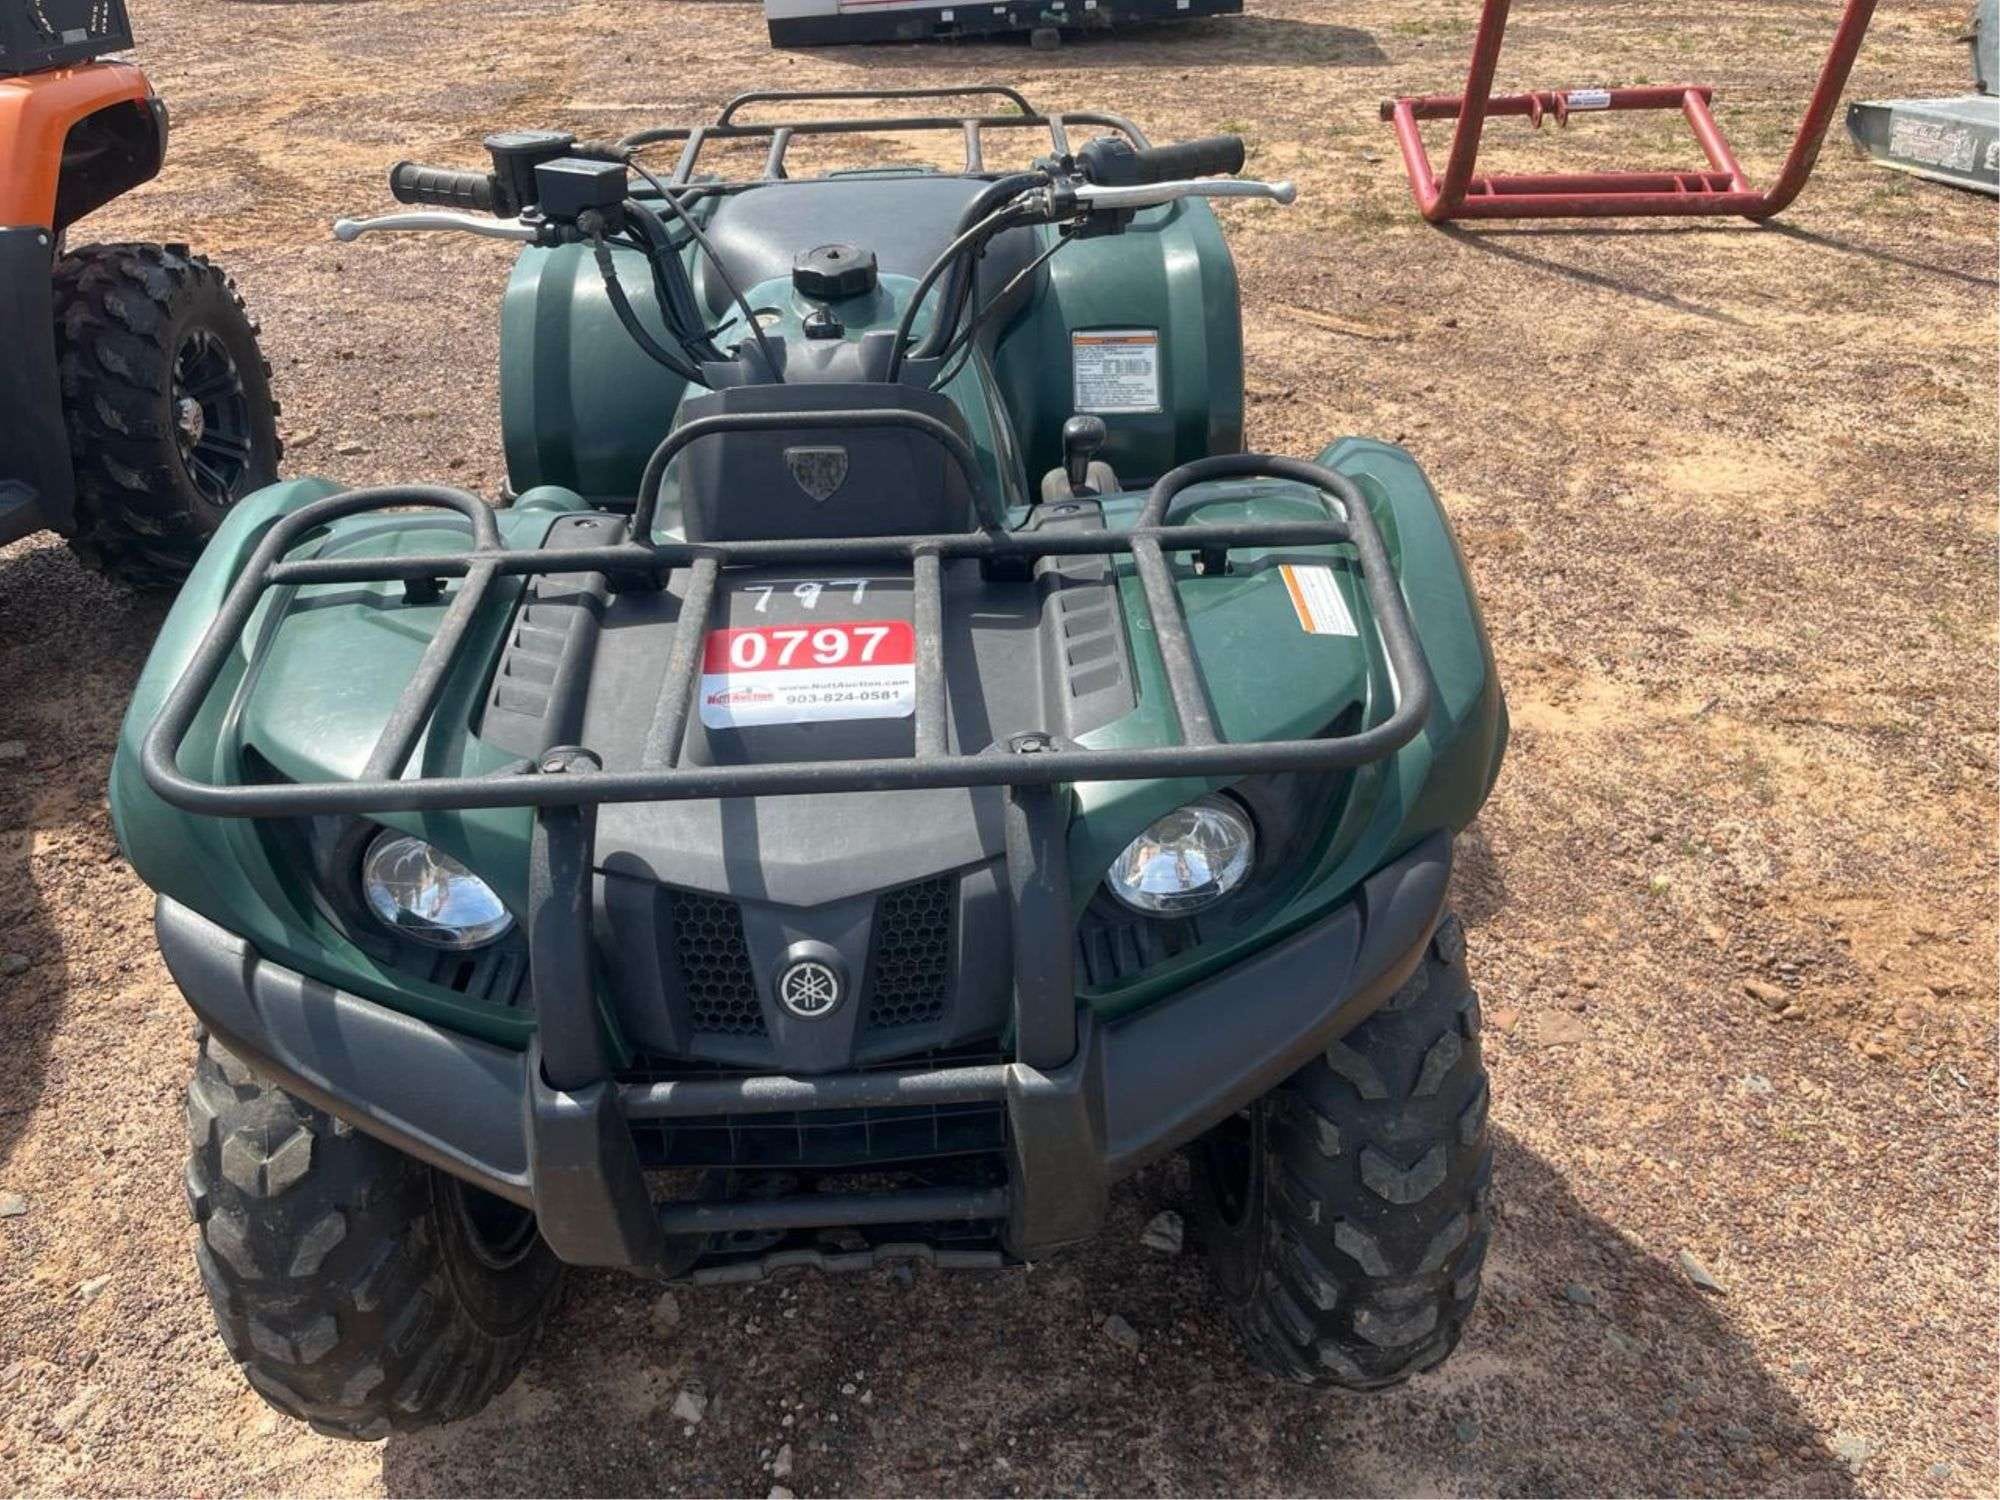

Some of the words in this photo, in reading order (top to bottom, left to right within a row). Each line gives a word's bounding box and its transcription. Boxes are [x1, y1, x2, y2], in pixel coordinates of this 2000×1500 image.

[743, 580, 869, 612] 797
[730, 626, 889, 668] 0797
[786, 690, 900, 704] 903-824-0581
